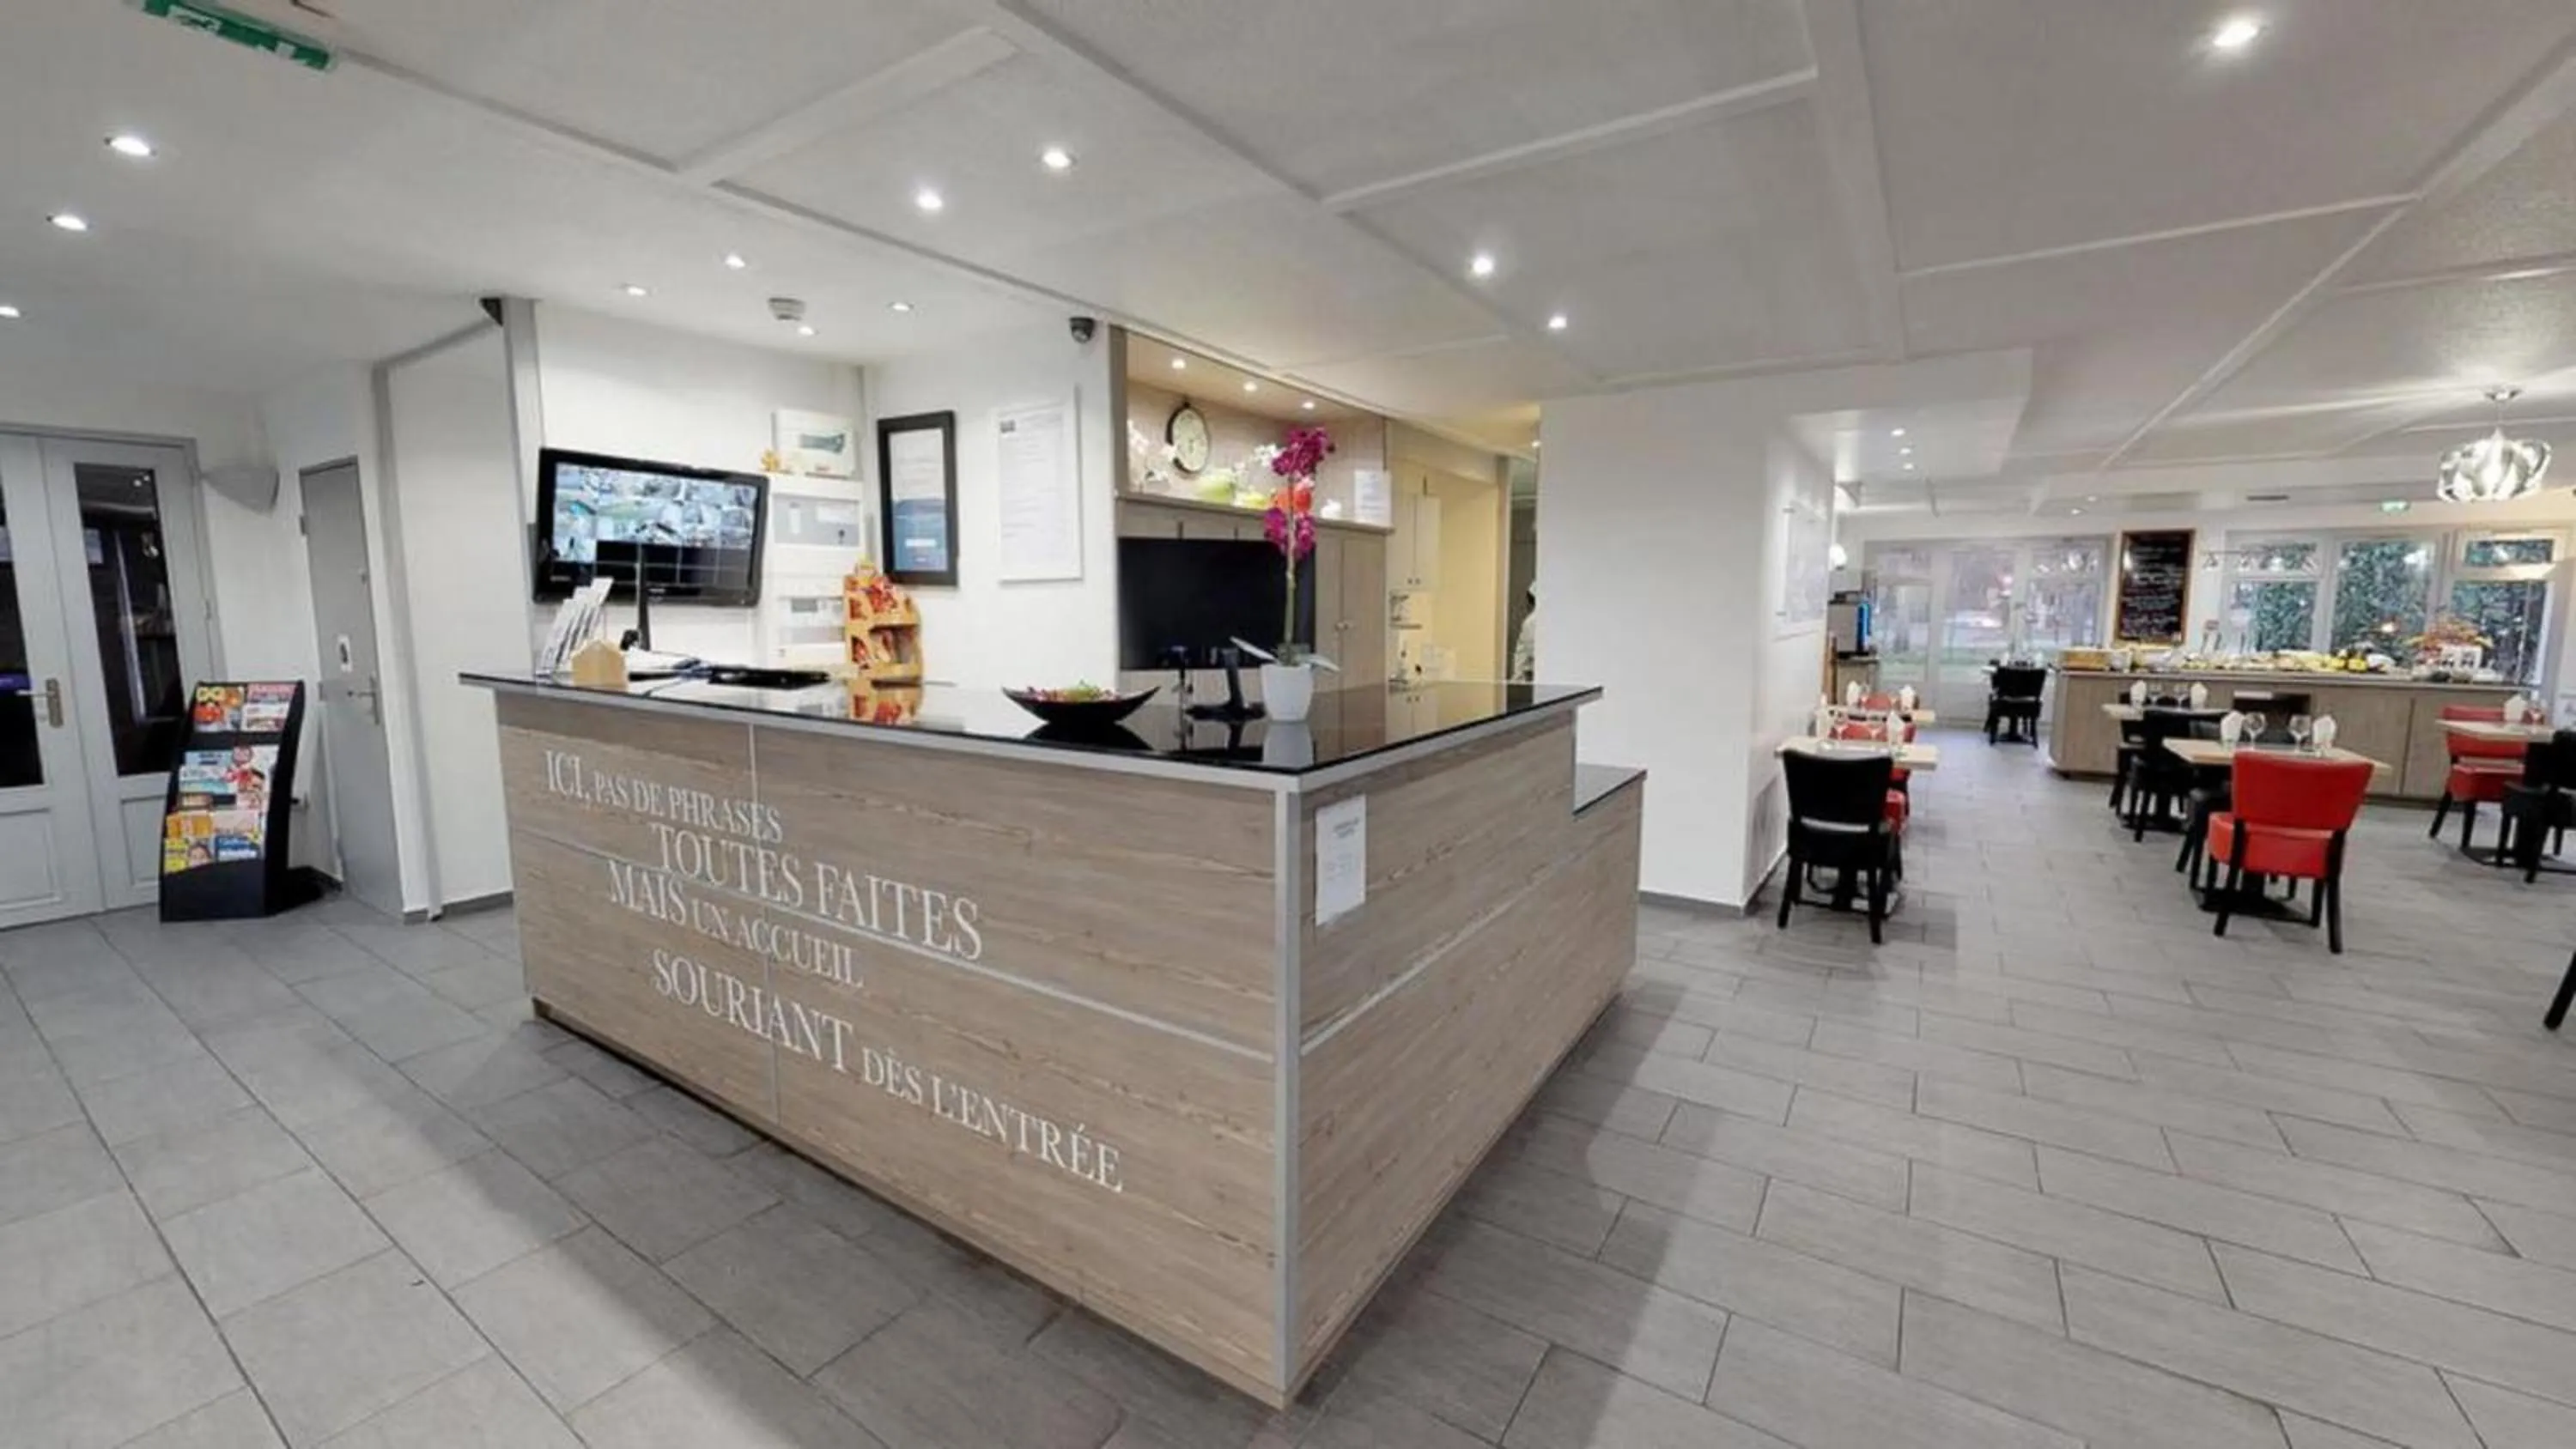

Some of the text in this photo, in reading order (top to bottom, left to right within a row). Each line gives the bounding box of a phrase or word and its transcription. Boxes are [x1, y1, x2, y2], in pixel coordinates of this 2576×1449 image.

[594, 770, 629, 809] PAS
[632, 779, 665, 816] DE
[668, 785, 783, 844] PHRASES
[609, 858, 864, 988] MAIS UN ACCUEIL
[648, 822, 982, 961] TOUTES FAITES
[653, 948, 1122, 1193] SOURIANT DÈS L'ENTRÉE
